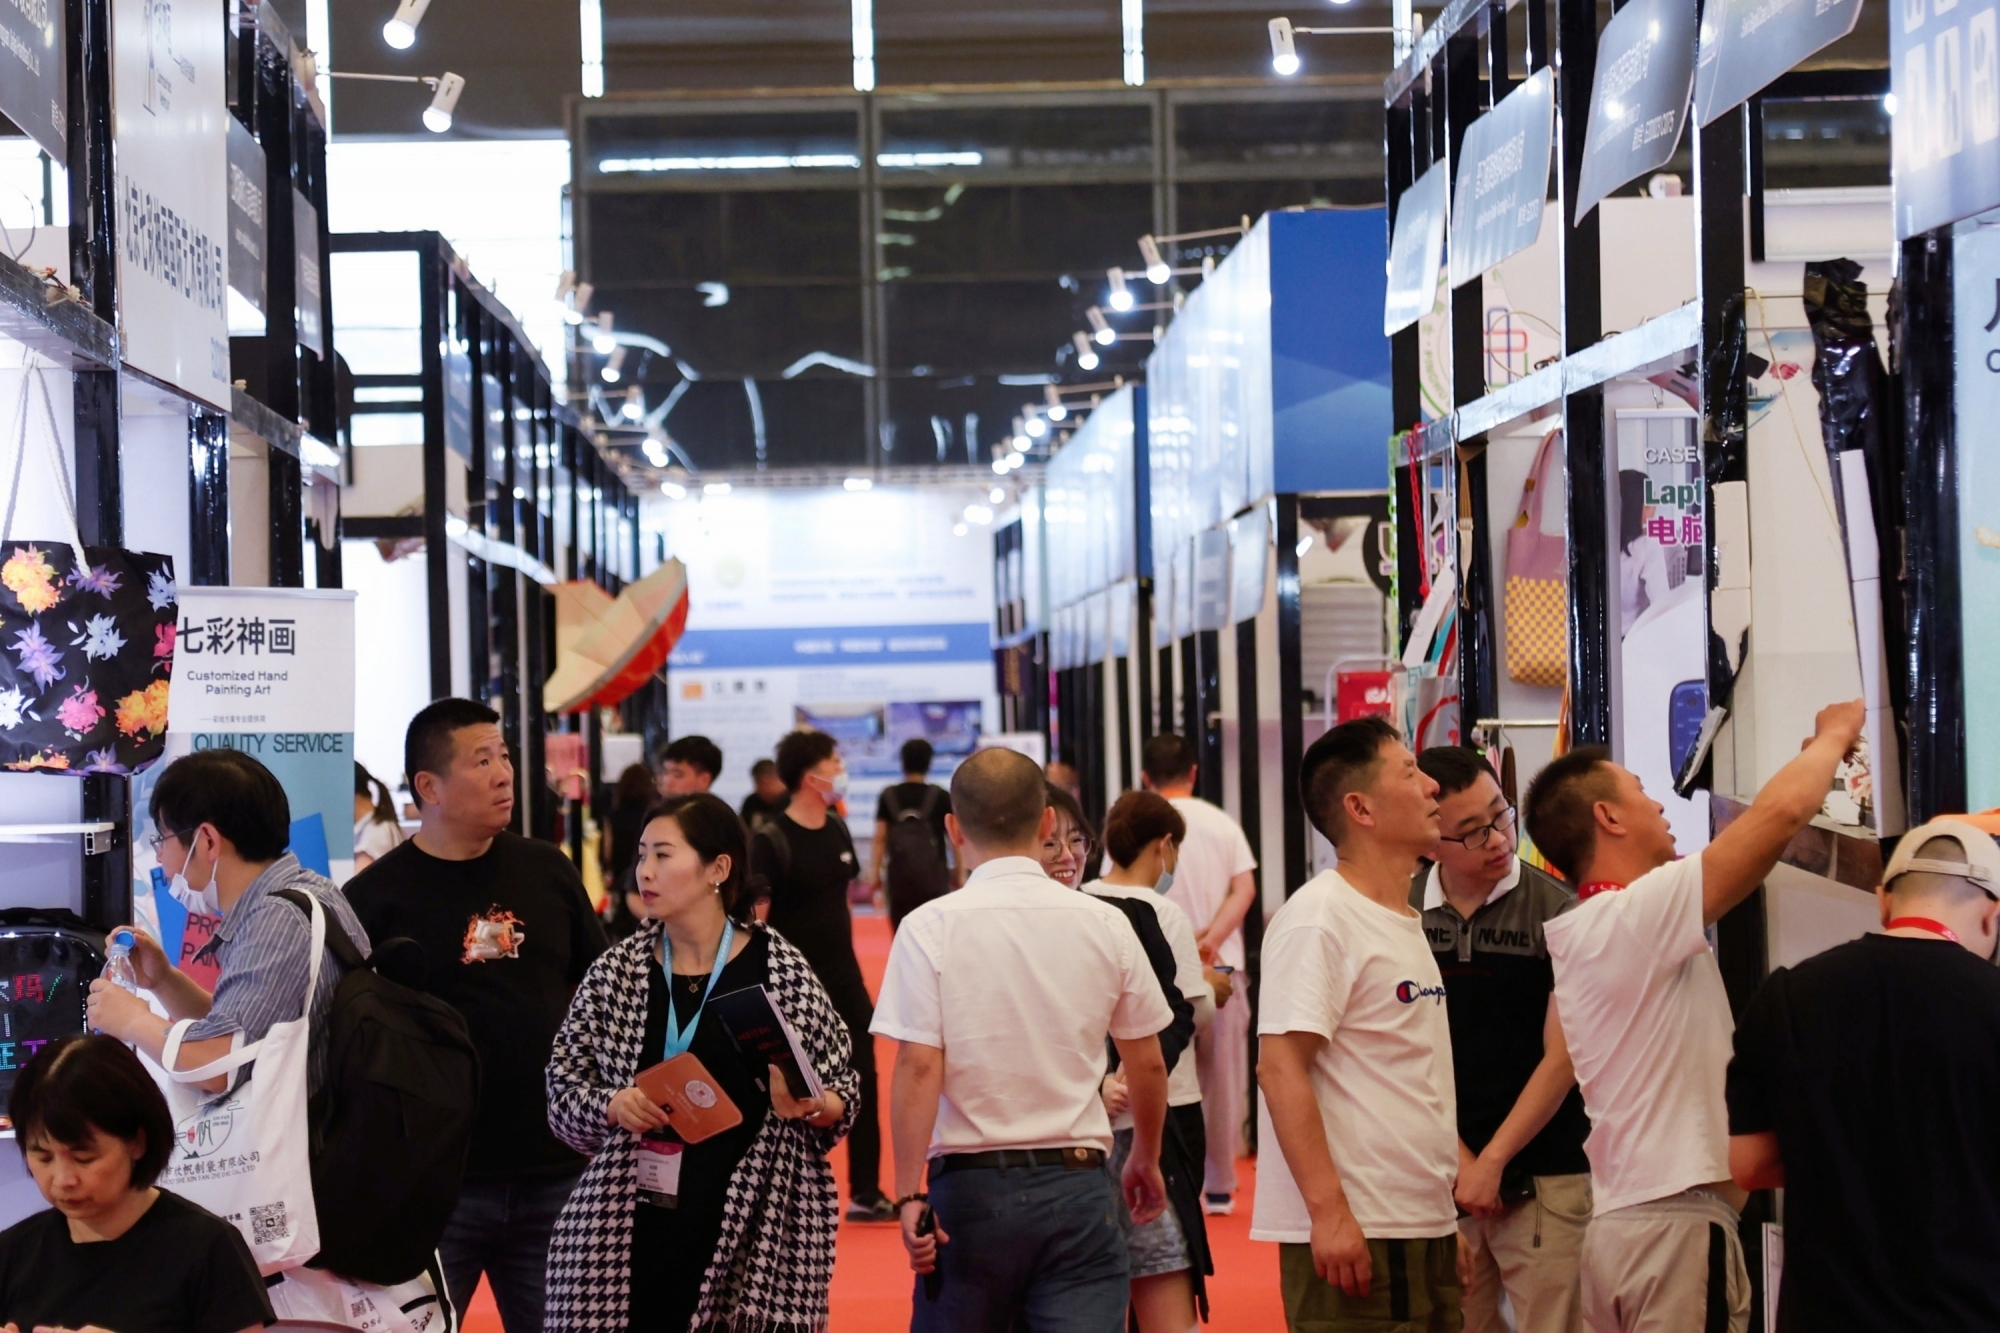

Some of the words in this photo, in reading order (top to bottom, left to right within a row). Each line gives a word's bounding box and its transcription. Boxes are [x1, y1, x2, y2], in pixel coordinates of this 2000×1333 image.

[176, 616, 295, 656] 七彩神画
[187, 670, 255, 681] Customized
[257, 670, 288, 681] Hand
[205, 684, 252, 697] Painting
[253, 685, 271, 695] Art
[272, 733, 343, 753] SERVICE
[1478, 928, 1530, 947] NUNE
